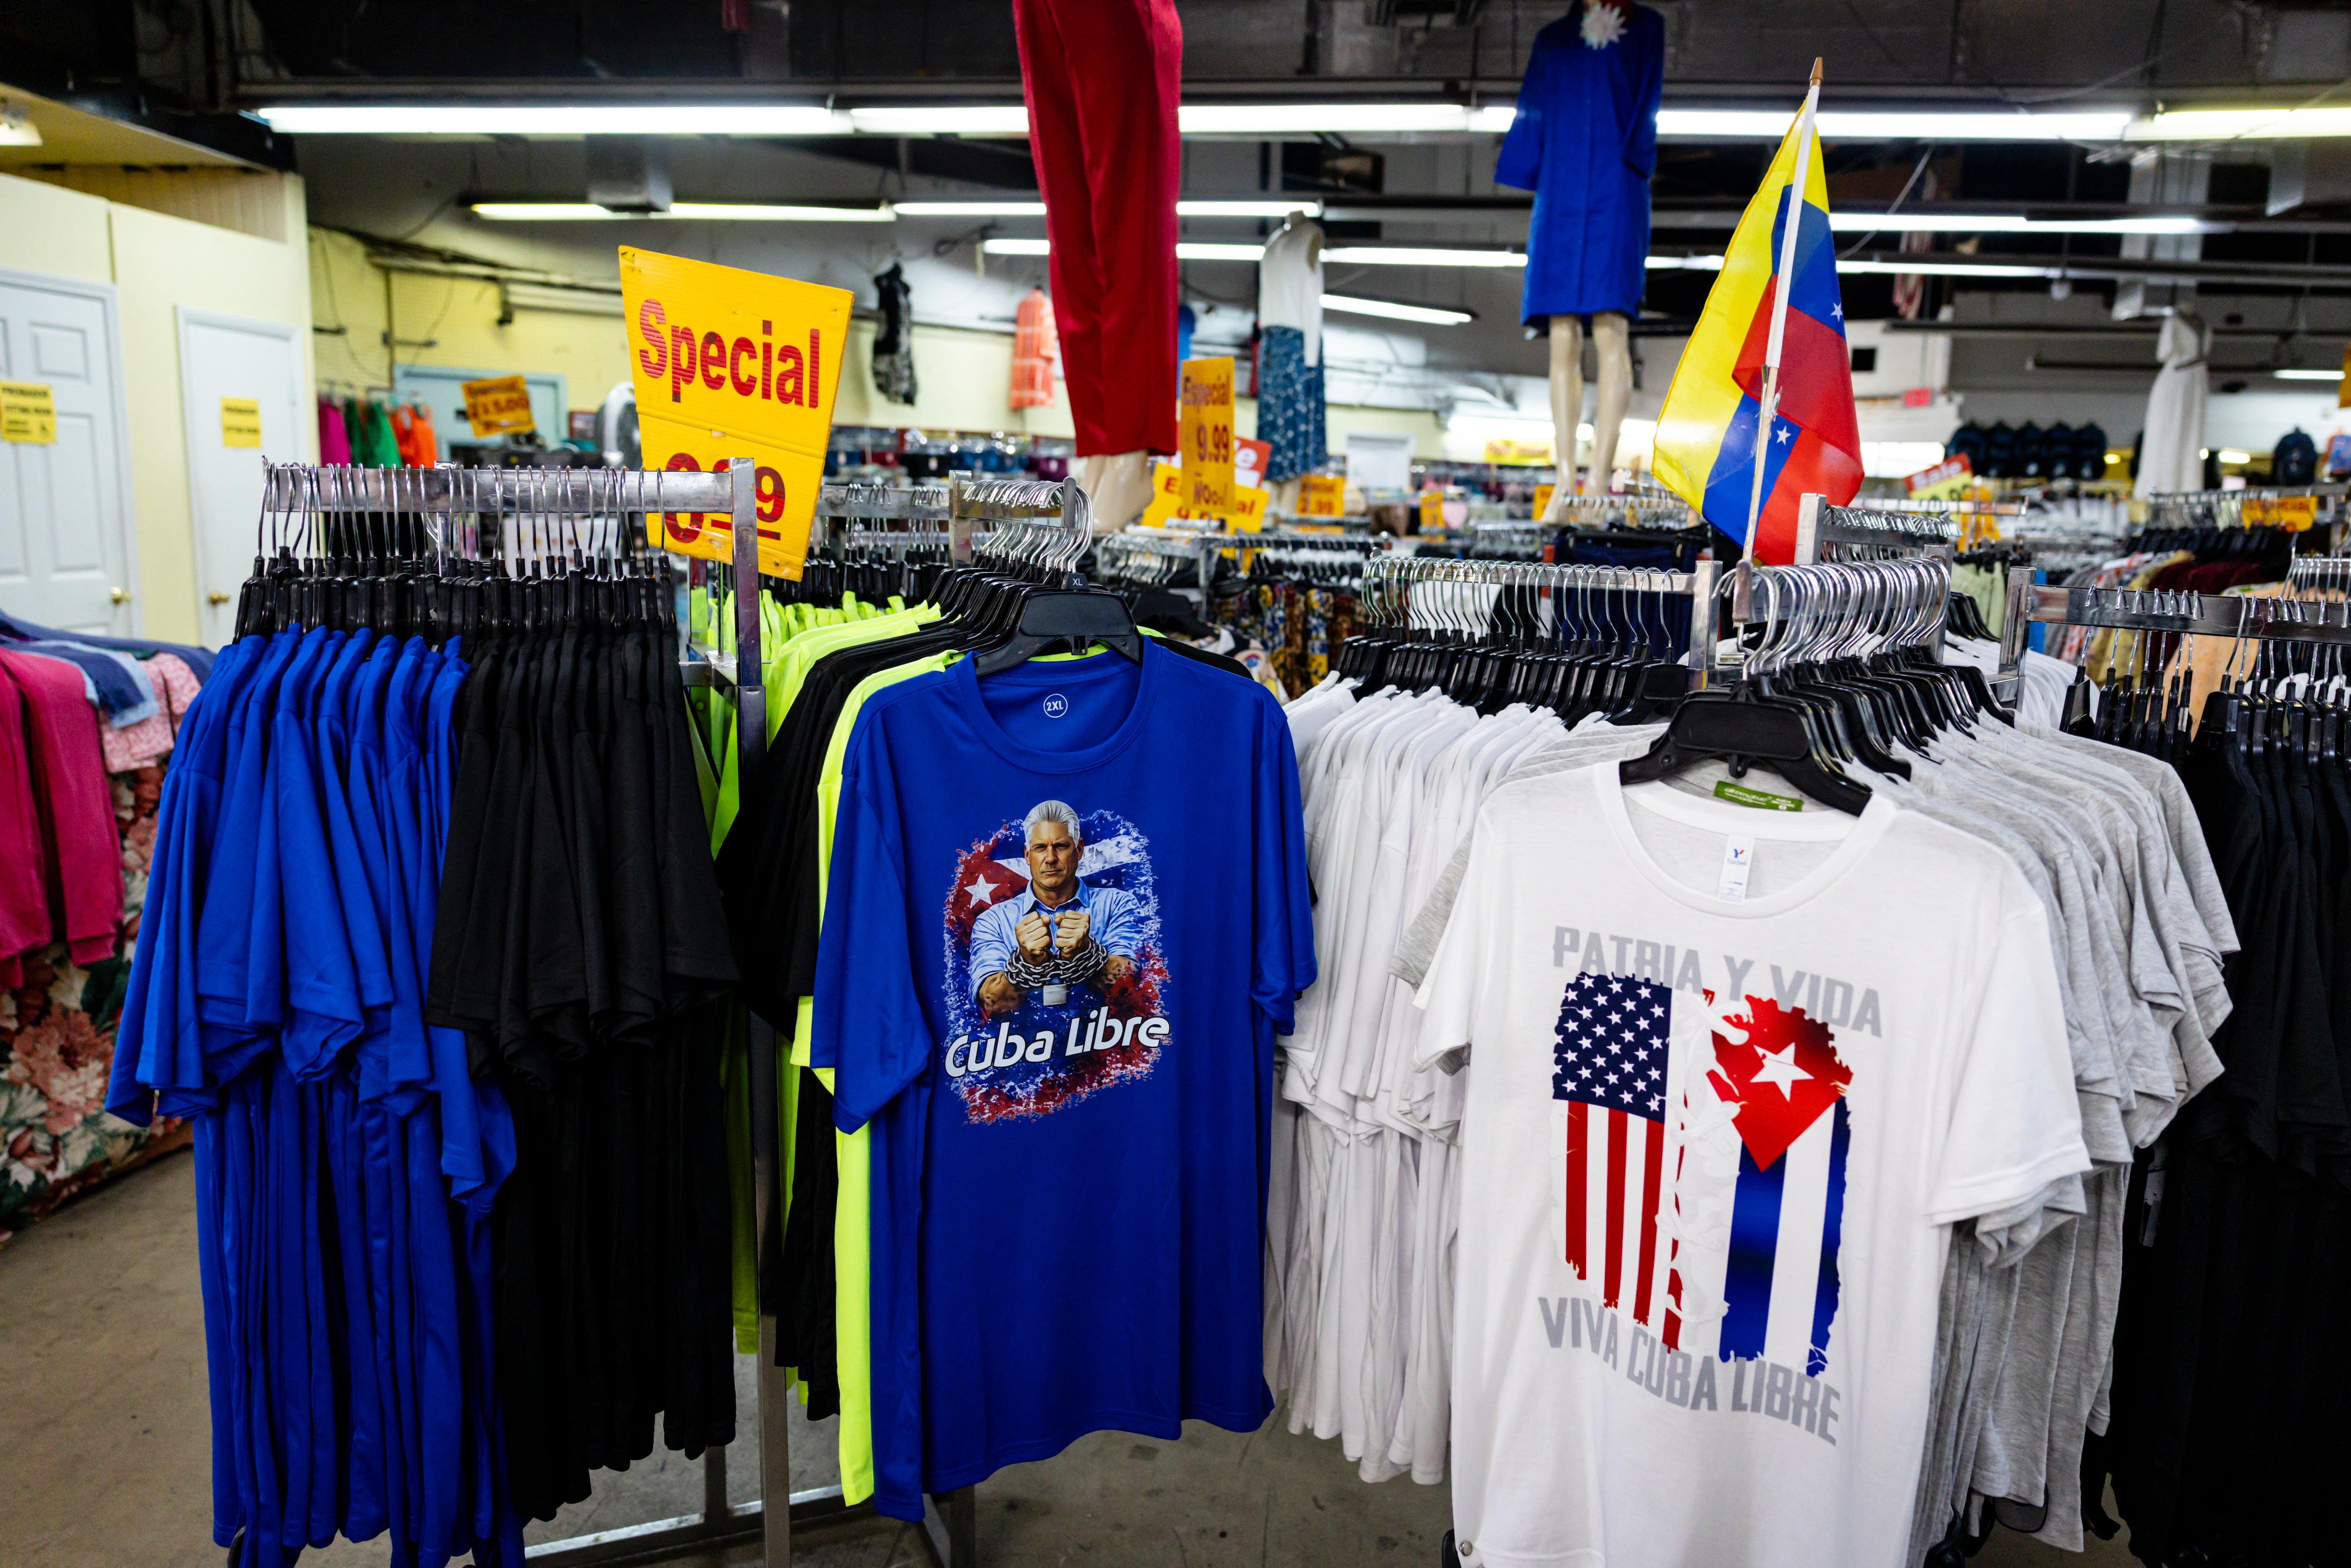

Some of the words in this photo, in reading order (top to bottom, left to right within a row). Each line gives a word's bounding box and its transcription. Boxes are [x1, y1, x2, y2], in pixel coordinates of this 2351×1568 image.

[639, 299, 820, 410] Special
[1197, 423, 1229, 464] 9.99
[1911, 461, 1963, 490] Sale
[1046, 701, 1064, 711] 2XL
[1553, 926, 1704, 994] PATRIA
[1724, 955, 1755, 1001] Y
[1771, 964, 1882, 1038] VIDA
[945, 1022, 1054, 1078] Cuba
[1065, 1006, 1171, 1057] Libre
[1538, 1297, 1618, 1371] VIVA
[1626, 1325, 1717, 1411] CUBA
[1732, 1357, 1841, 1446] LIBRE
